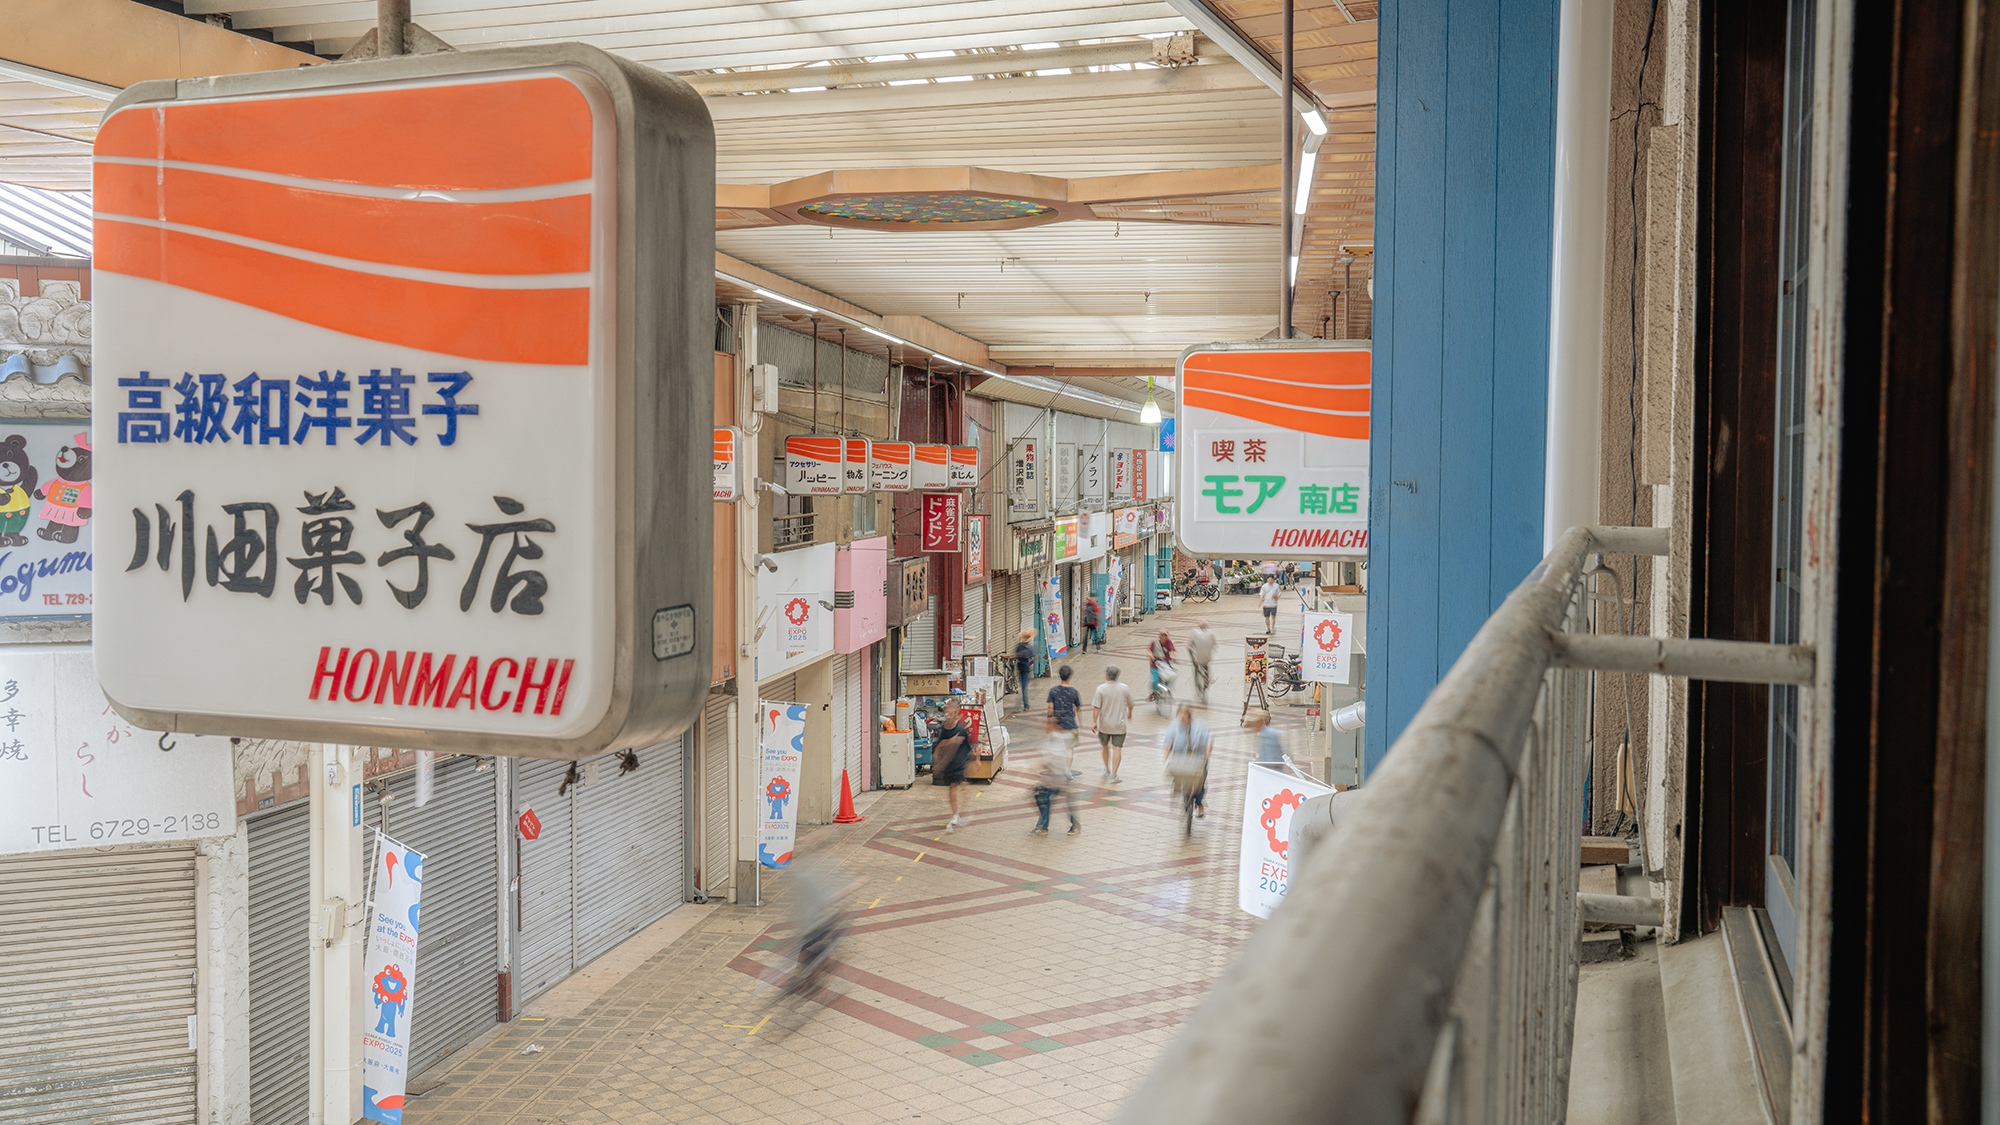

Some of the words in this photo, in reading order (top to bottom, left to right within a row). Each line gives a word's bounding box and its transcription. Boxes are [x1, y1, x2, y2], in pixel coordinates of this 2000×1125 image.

[117, 369, 480, 447] 高級和洋菓子
[1212, 438, 1267, 463] 喫茶
[1201, 475, 1286, 514] モア
[1299, 482, 1360, 515] 南店
[928, 497, 942, 547] ドンドン
[945, 497, 957, 544] 麻雀クラブ
[125, 486, 556, 616] 川田菓子店
[0, 550, 92, 602] ogum
[42, 593, 63, 606] TEL
[1316, 655, 1337, 663] EXPO
[1316, 662, 1337, 670] 2025
[309, 646, 575, 716] HONMACHI
[31, 825, 77, 844] TEL
[90, 812, 220, 840] 6729-2138
[1260, 876, 1288, 897] 202
[378, 912, 394, 925] See
[376, 925, 386, 934] at
[387, 926, 399, 939] the
[399, 931, 415, 948] EXPO
